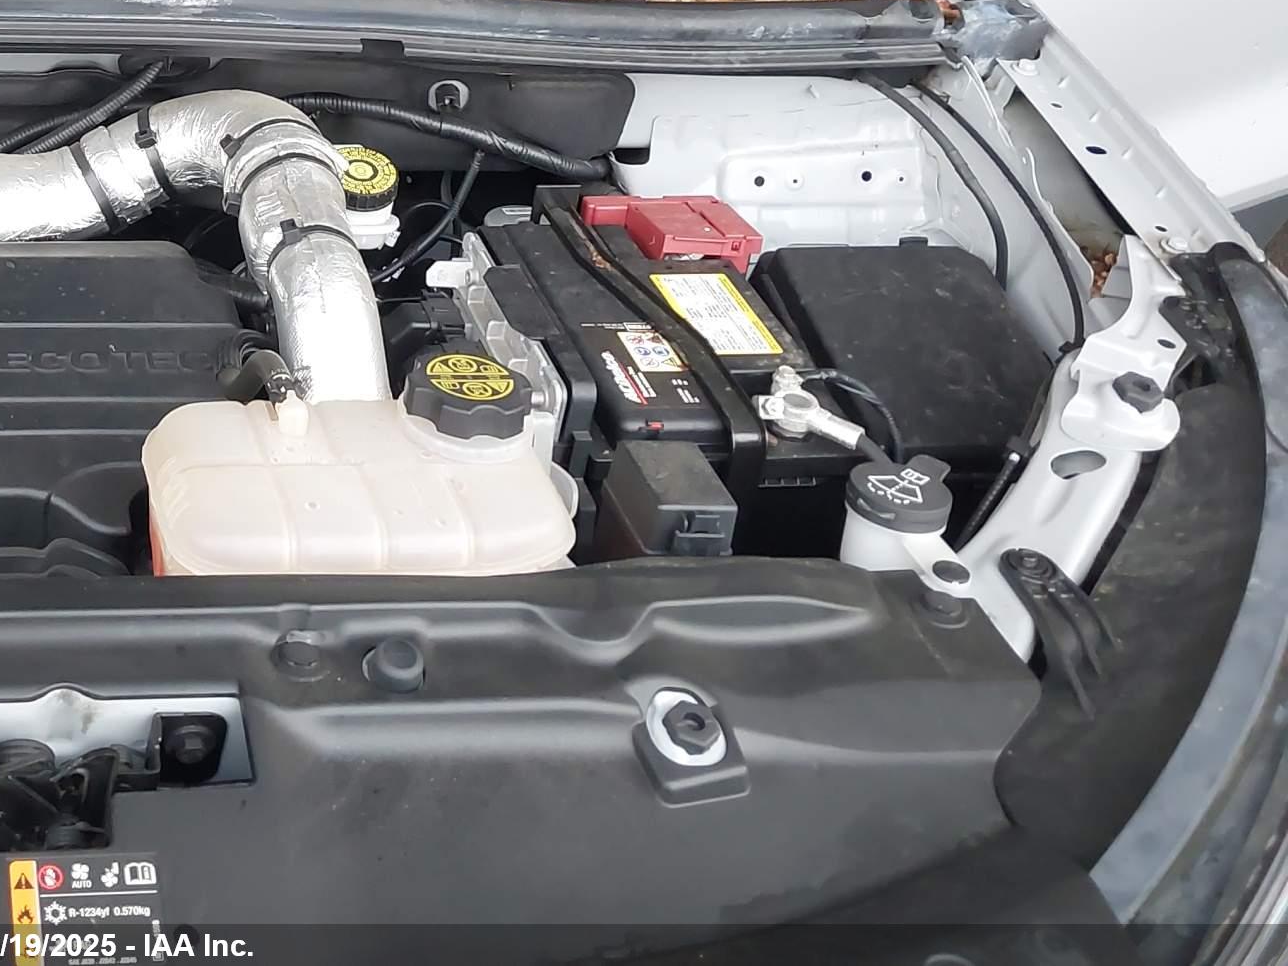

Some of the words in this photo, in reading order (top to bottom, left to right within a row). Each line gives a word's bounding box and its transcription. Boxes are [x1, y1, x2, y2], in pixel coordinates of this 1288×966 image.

[71, 879, 92, 889] AUTO
[68, 907, 110, 919] R-1234yf
[113, 905, 151, 917] 0.570kg
